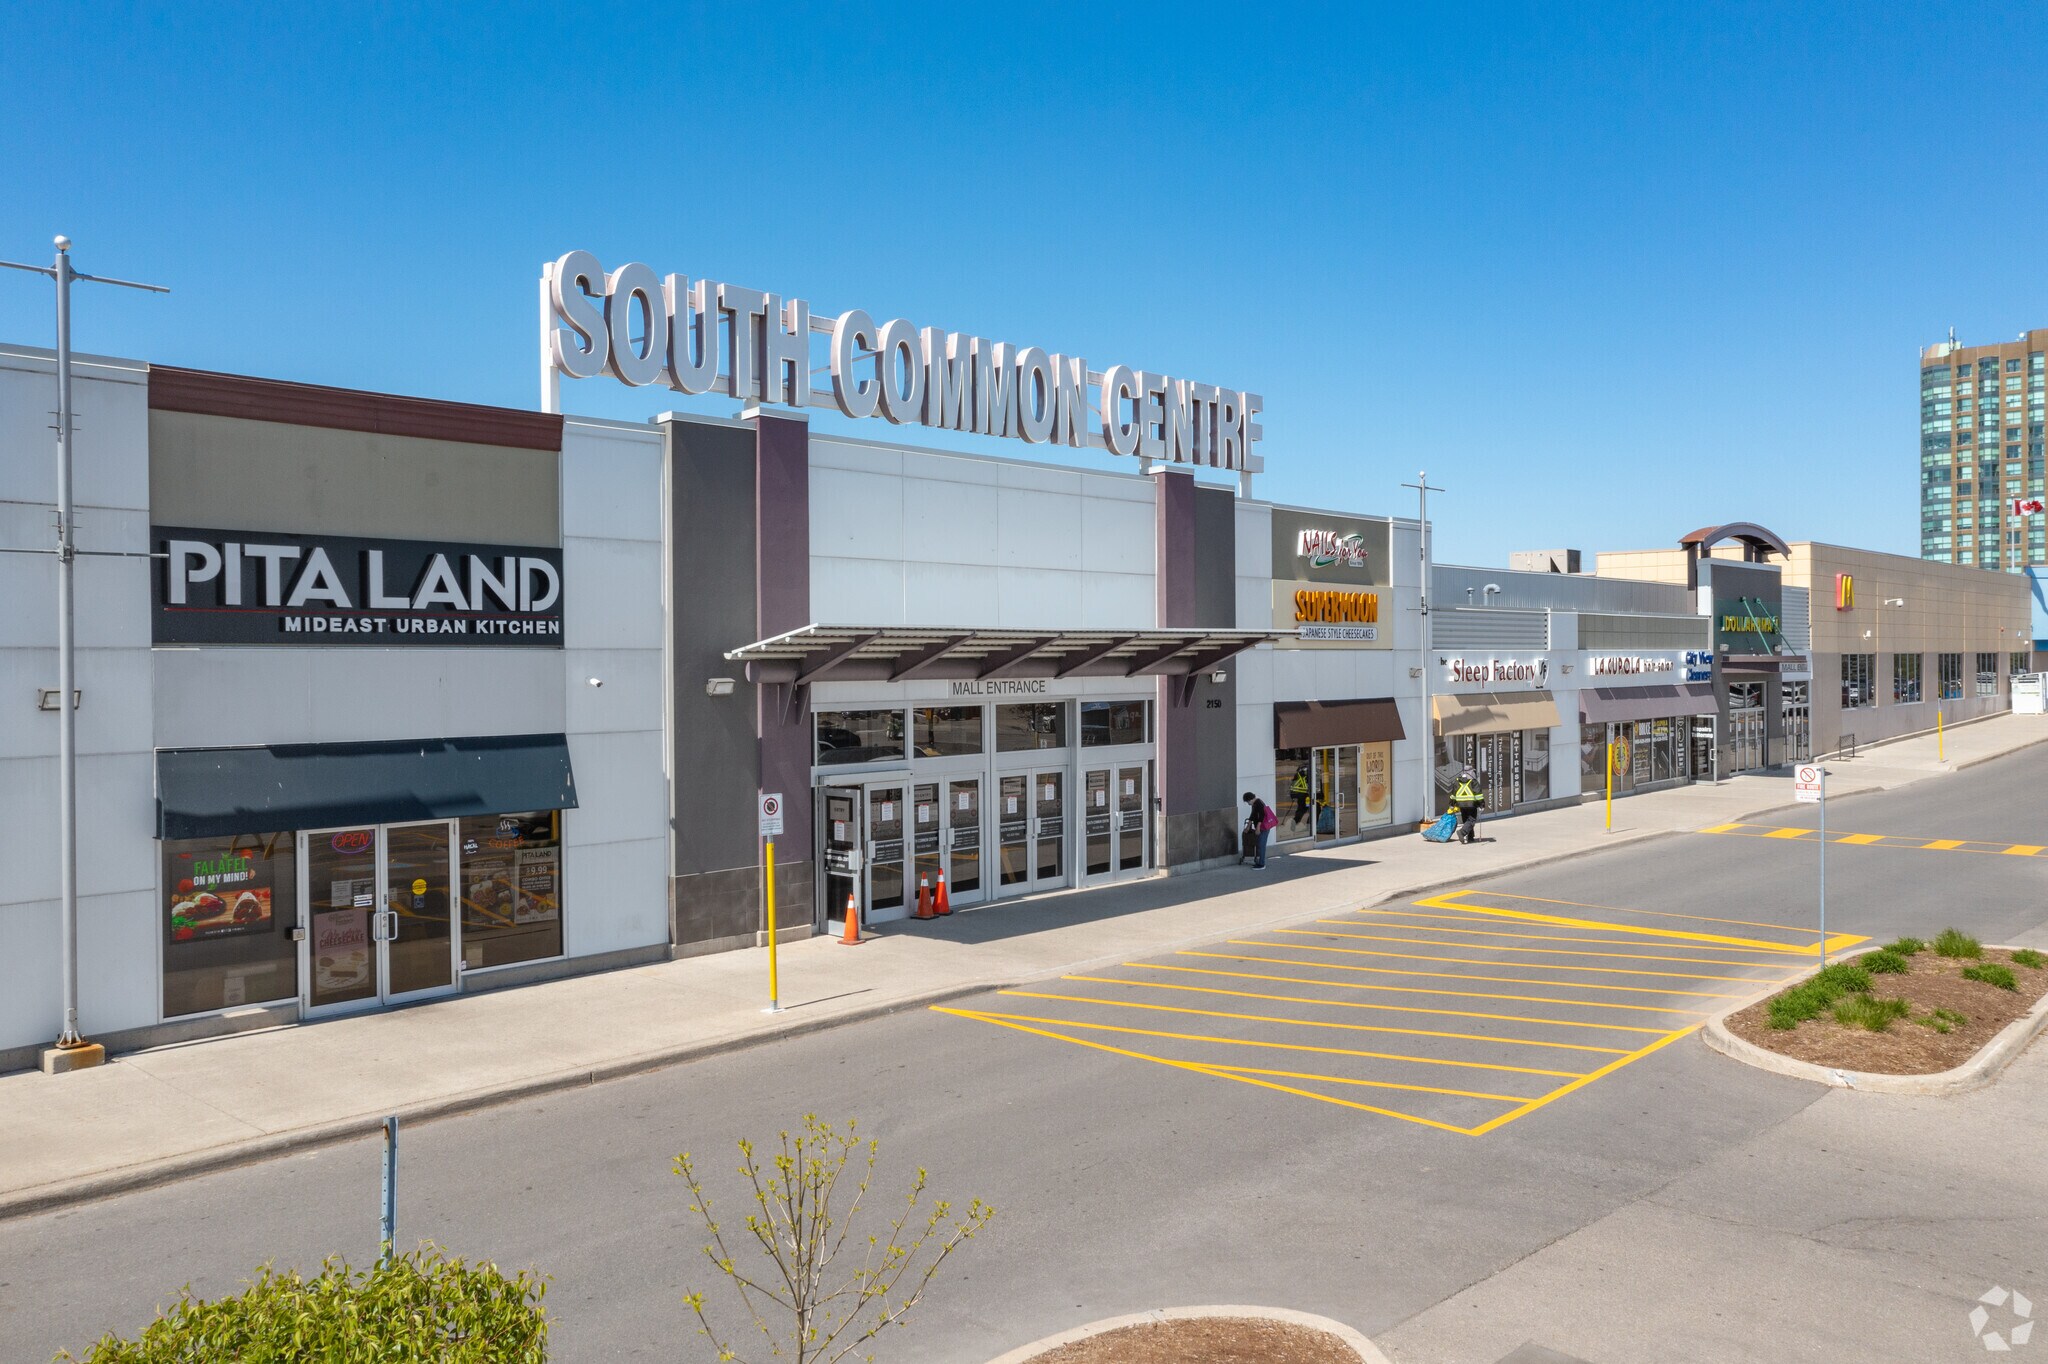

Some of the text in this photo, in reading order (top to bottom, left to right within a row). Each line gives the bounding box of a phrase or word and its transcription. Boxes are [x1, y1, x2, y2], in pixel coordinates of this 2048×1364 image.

[551, 250, 1264, 474] SOUTH COMMON CENTRE
[1300, 529, 1337, 557] NAILS
[169, 540, 560, 612] PITA LAND
[1295, 589, 1378, 623] SUPERMOON
[285, 616, 560, 634] MIDEAST URBAN KITCHEN
[1328, 628, 1341, 638] STYLE
[1342, 628, 1375, 639] CHEESECAKES
[1452, 659, 1537, 688] Sleep Factory
[1594, 658, 1604, 675] LA
[1607, 657, 1640, 675] CUPOLA
[952, 680, 1046, 695] MALL ENTRANCE
[1206, 699, 1222, 709] 2150
[334, 833, 369, 847] OPEN
[488, 835, 525, 848] COFFEE
[194, 858, 248, 875] FALAFEL
[193, 871, 248, 886] ON MY MIND!
[320, 932, 365, 948] CHEESECAKE
